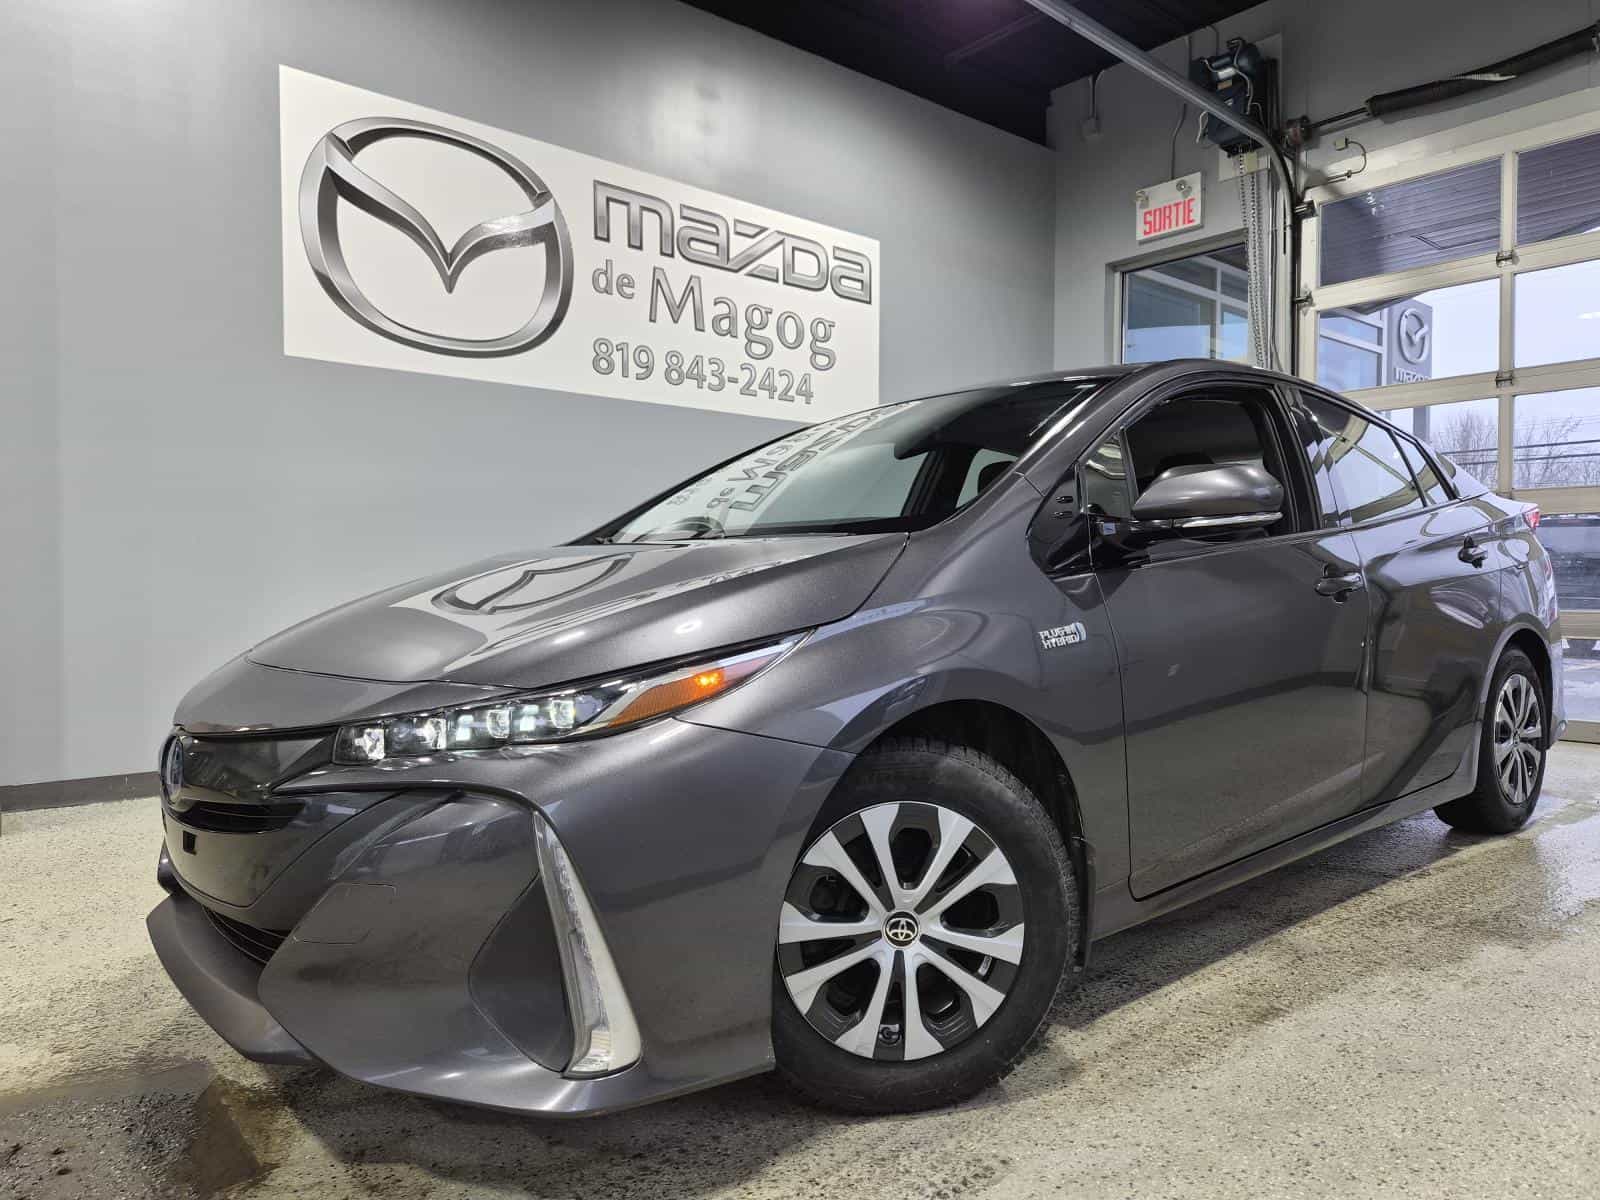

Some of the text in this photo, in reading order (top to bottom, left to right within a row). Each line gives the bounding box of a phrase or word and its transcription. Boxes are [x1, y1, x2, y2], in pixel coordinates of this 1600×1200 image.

[1143, 198, 1196, 236] SORTIE
[591, 259, 836, 371] de Magog
[592, 338, 814, 404] 819 843-2424
